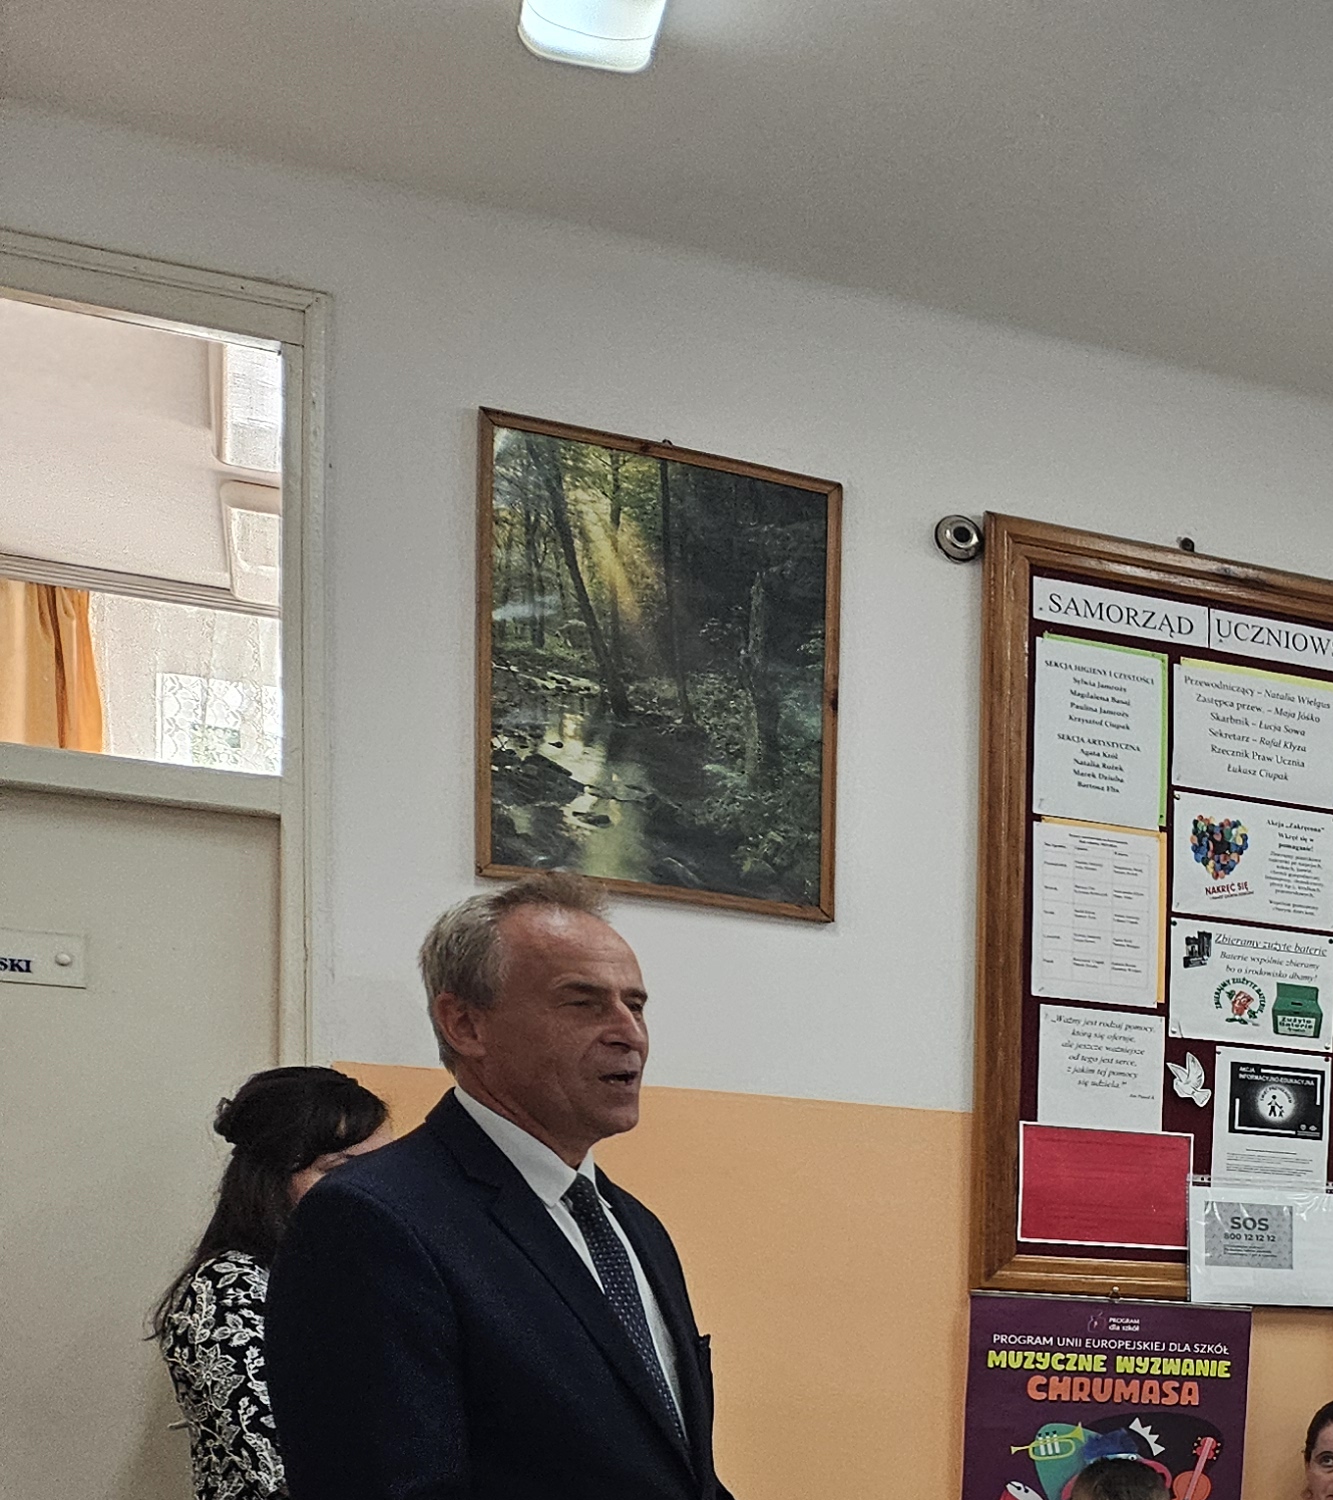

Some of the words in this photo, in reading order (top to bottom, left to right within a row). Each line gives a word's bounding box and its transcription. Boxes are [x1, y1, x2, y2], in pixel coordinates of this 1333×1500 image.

[1049, 593, 1194, 638] SAMORZĄD
[1184, 675, 1254, 697] Przewodniczący
[1264, 689, 1295, 702] Natalia
[1298, 695, 1330, 710] Wielgus
[1196, 693, 1234, 708] Zastępca
[1274, 708, 1295, 719] Maja
[1209, 728, 1249, 743] Sekretarz
[1210, 712, 1249, 727] Skarbnik
[1284, 724, 1306, 736] Sowa
[1211, 744, 1249, 759] Rzecznik
[1252, 751, 1272, 763] Praw
[1276, 755, 1305, 768] Ucznia
[1227, 764, 1256, 776] Łukasz
[1259, 769, 1288, 781] Ciupak
[1215, 933, 1261, 948] Zbieramy
[1295, 943, 1327, 956] baterie
[1220, 951, 1248, 962] Baterie
[1285, 959, 1320, 970] zbieramy
[1226, 965, 1235, 973] bo
[1244, 965, 1287, 979] środowisko
[1230, 1216, 1269, 1231] SOS
[1224, 1232, 1242, 1241] 800
[1244, 1233, 1254, 1241] 12
[1256, 1233, 1264, 1242] 12
[1267, 1234, 1276, 1242] 12
[993, 1334, 1053, 1346] PROGRAM
[1057, 1337, 1082, 1348] UNII
[1085, 1339, 1166, 1352] EUROPEJSKIEJ
[1169, 1342, 1191, 1353] DLA
[1193, 1343, 1229, 1355] SZKÓŁ
[987, 1350, 1108, 1373] MUZYCZNE
[1115, 1355, 1232, 1378] WYZWANIE
[1027, 1375, 1200, 1406] CHRUMASA
